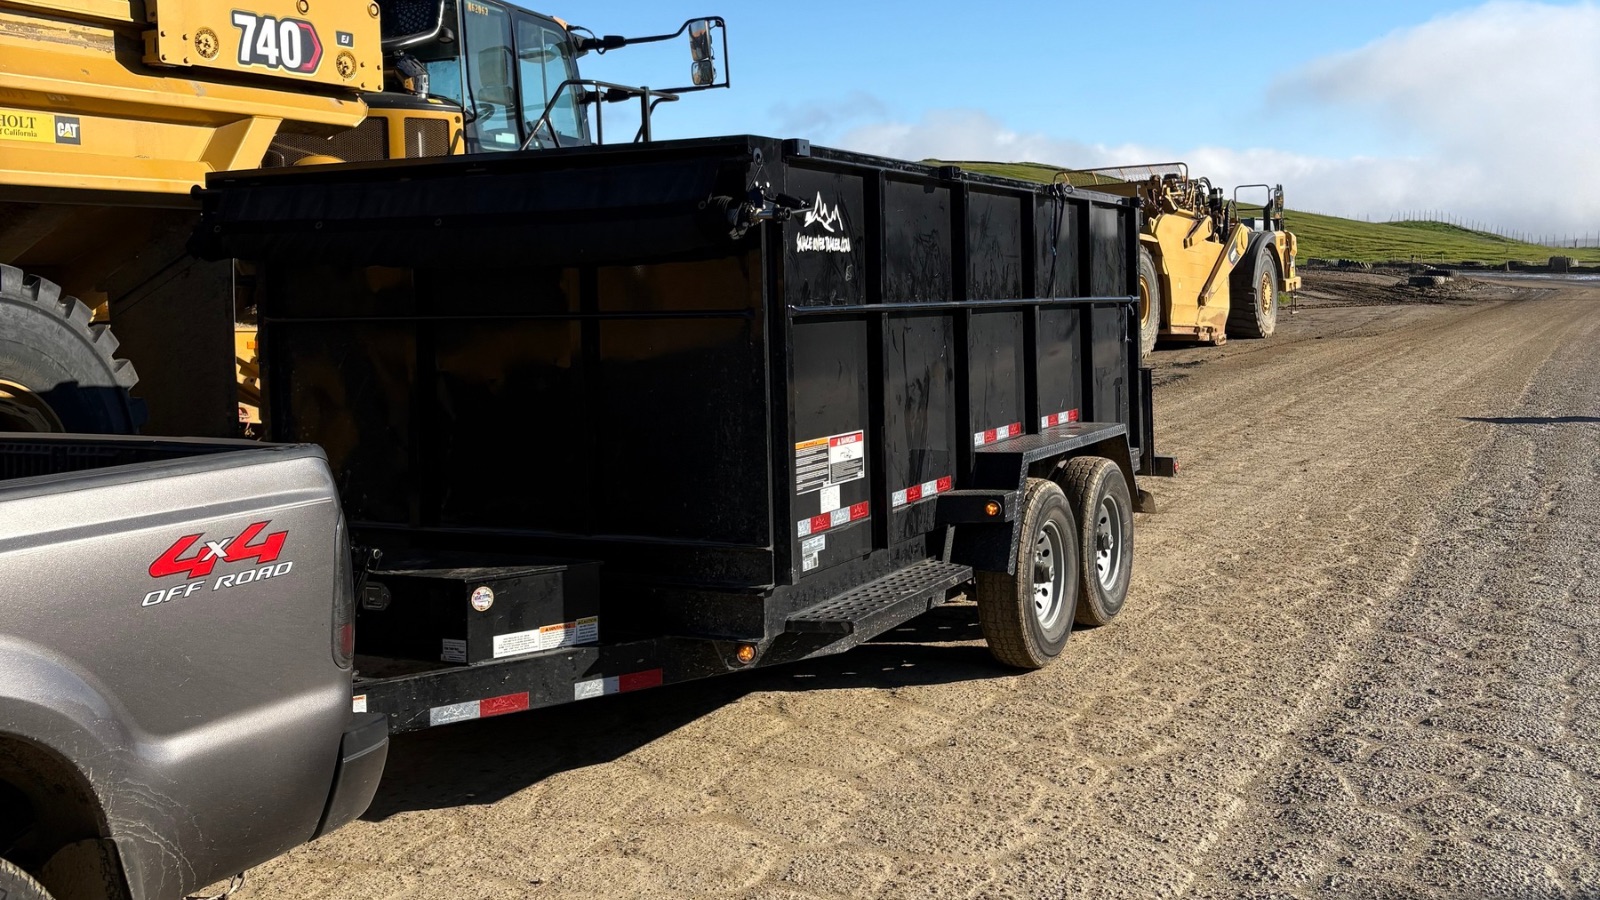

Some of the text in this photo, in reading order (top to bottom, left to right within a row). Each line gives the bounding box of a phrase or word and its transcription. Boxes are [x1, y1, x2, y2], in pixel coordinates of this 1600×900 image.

[233, 13, 302, 69] 740
[4, 128, 38, 138] California
[56, 122, 80, 138] CAT
[141, 561, 294, 608] OFF ROAD
